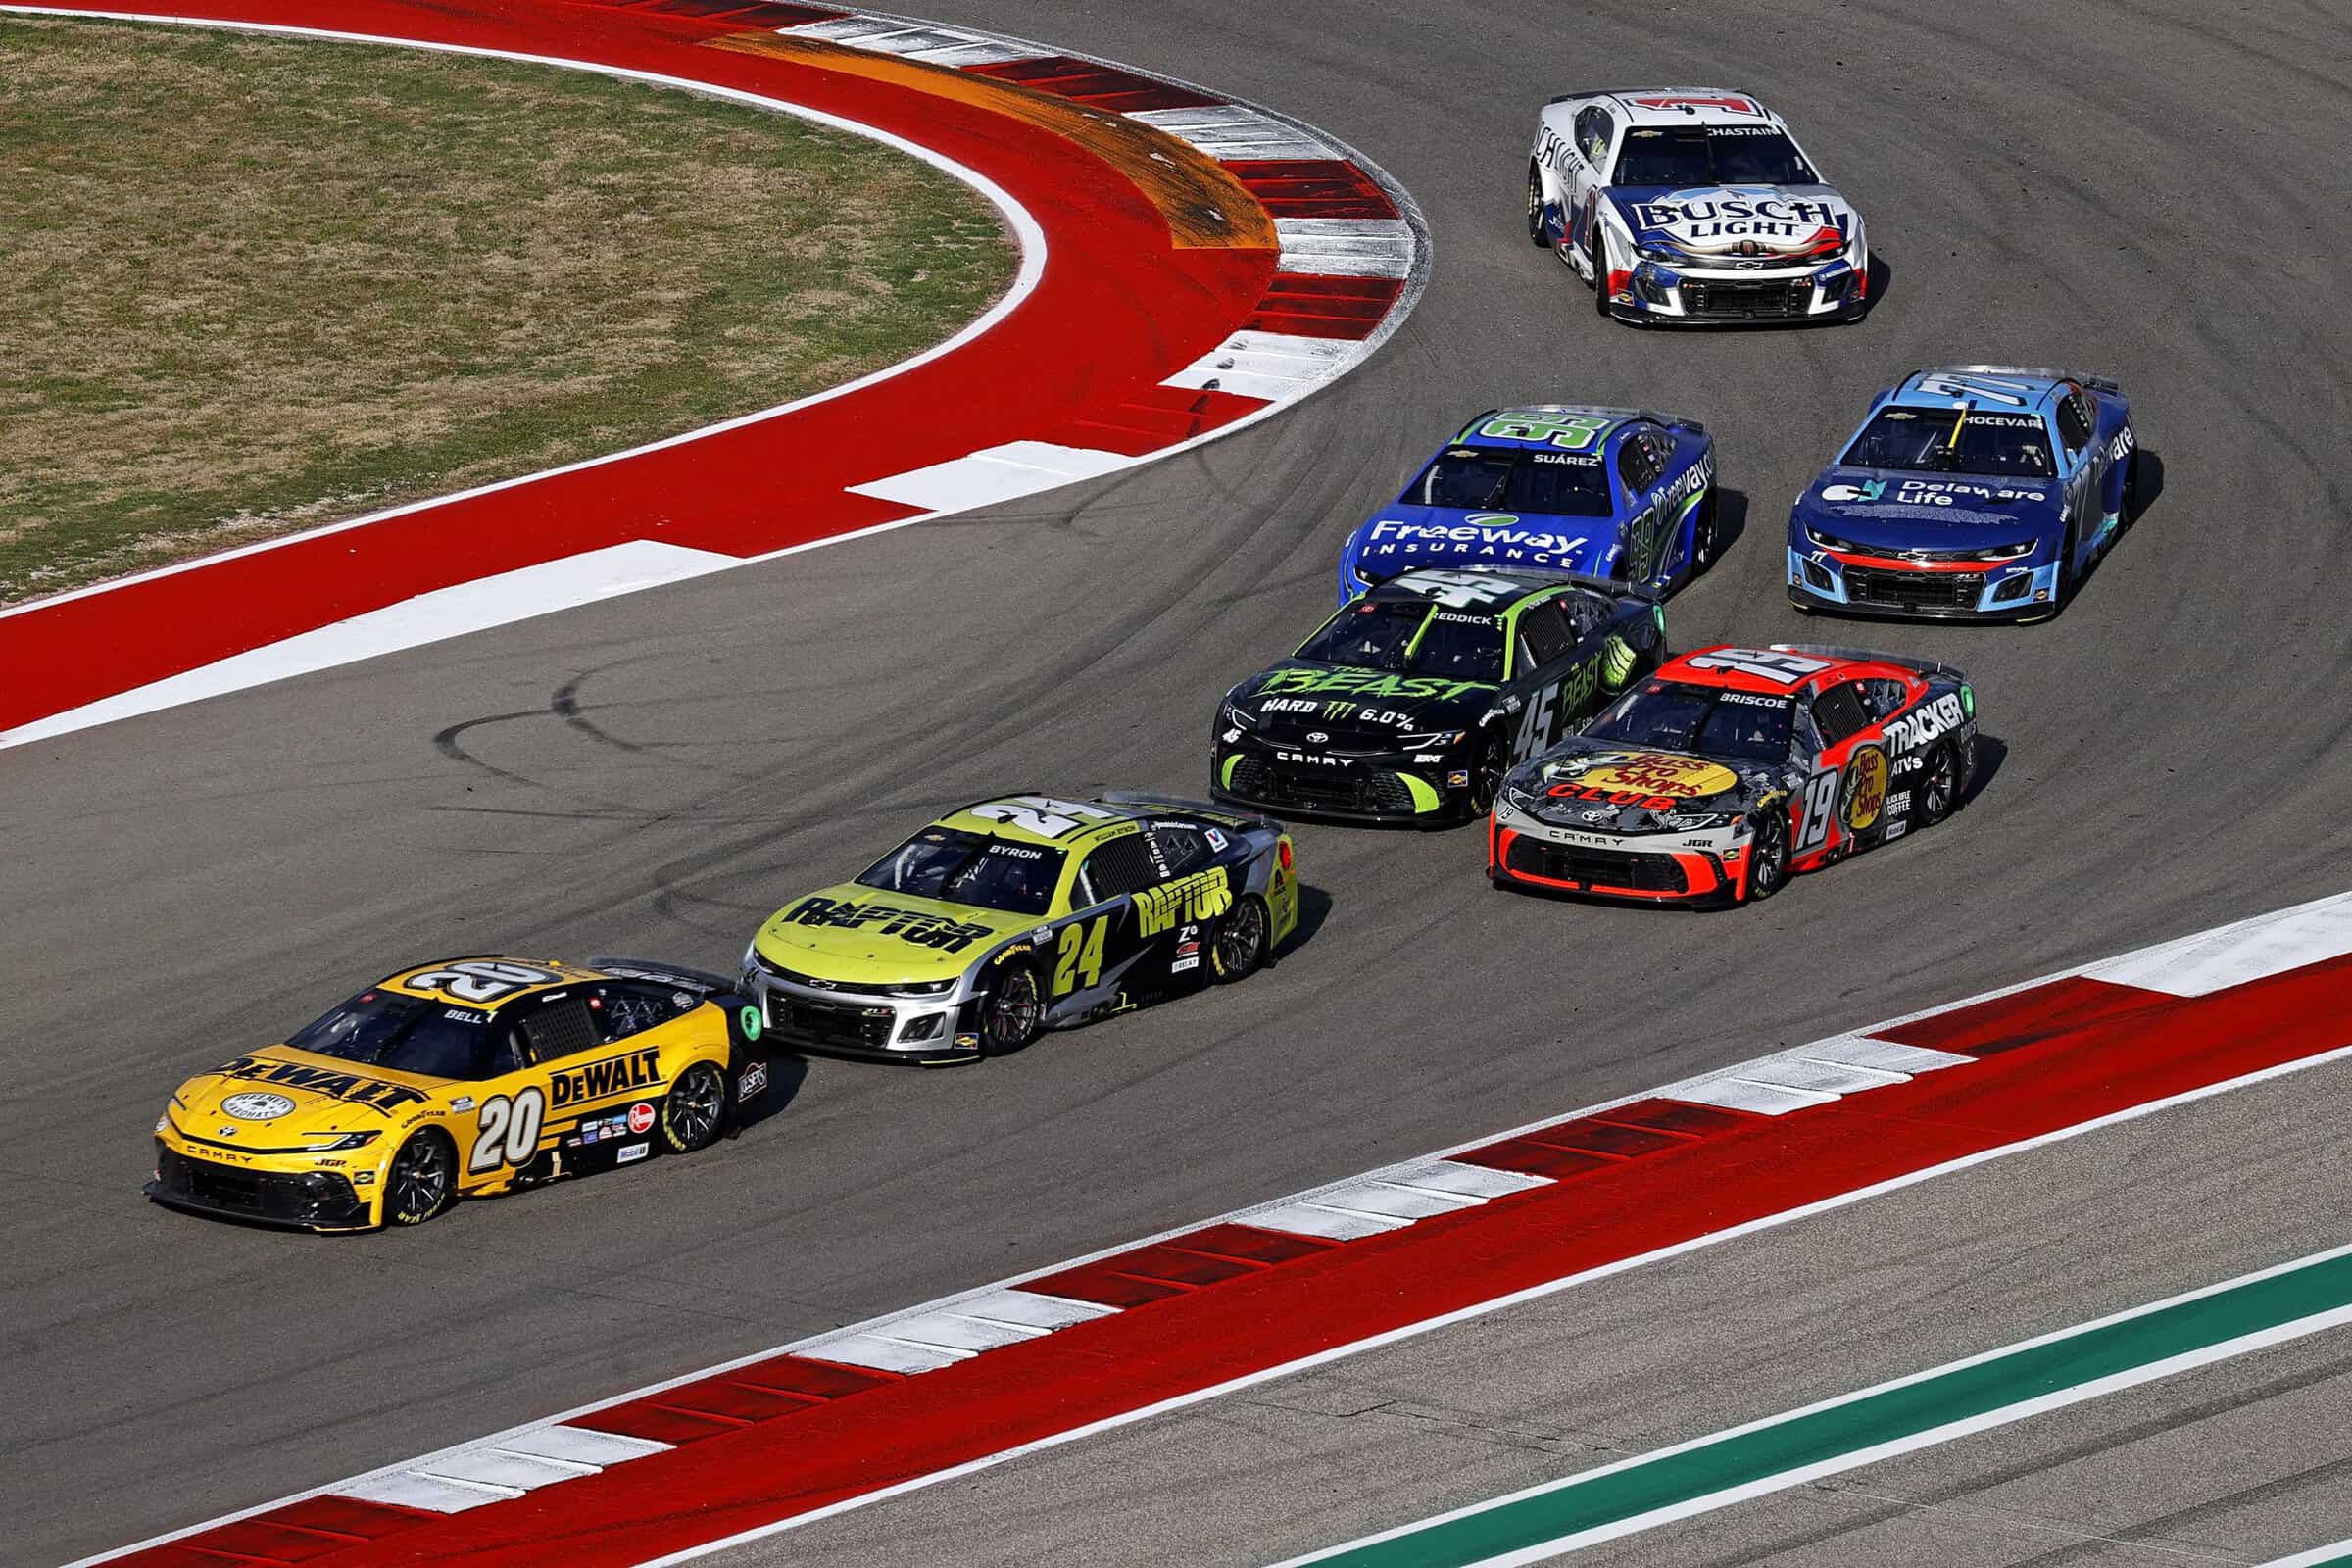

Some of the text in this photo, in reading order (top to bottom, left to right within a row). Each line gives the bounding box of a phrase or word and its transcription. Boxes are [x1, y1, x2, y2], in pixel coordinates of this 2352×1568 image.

[1637, 201, 1835, 228] BUSCH
[1690, 221, 1799, 238] LIGHT
[1533, 453, 1598, 466] SUÁREZ
[1896, 491, 1953, 505] Life
[1900, 481, 2045, 502] Delaware
[1362, 543, 1573, 568] INSURANCE
[1260, 698, 1318, 713] HARD
[1719, 692, 1788, 709] BRISCOE
[1359, 709, 1415, 732] 6.0%
[1882, 692, 1965, 758] TRACKER
[1276, 751, 1354, 767] CAMRY
[1547, 783, 1678, 810] CLUB
[1795, 770, 1838, 852] 19
[1549, 830, 1625, 847] CAMRY
[1682, 839, 1713, 848] JGR
[989, 845, 1043, 860] BYRON
[1052, 915, 1109, 997] 24
[444, 1009, 482, 1024] BELL
[468, 1088, 544, 1174] 20
[187, 1145, 252, 1163] CAMRY
